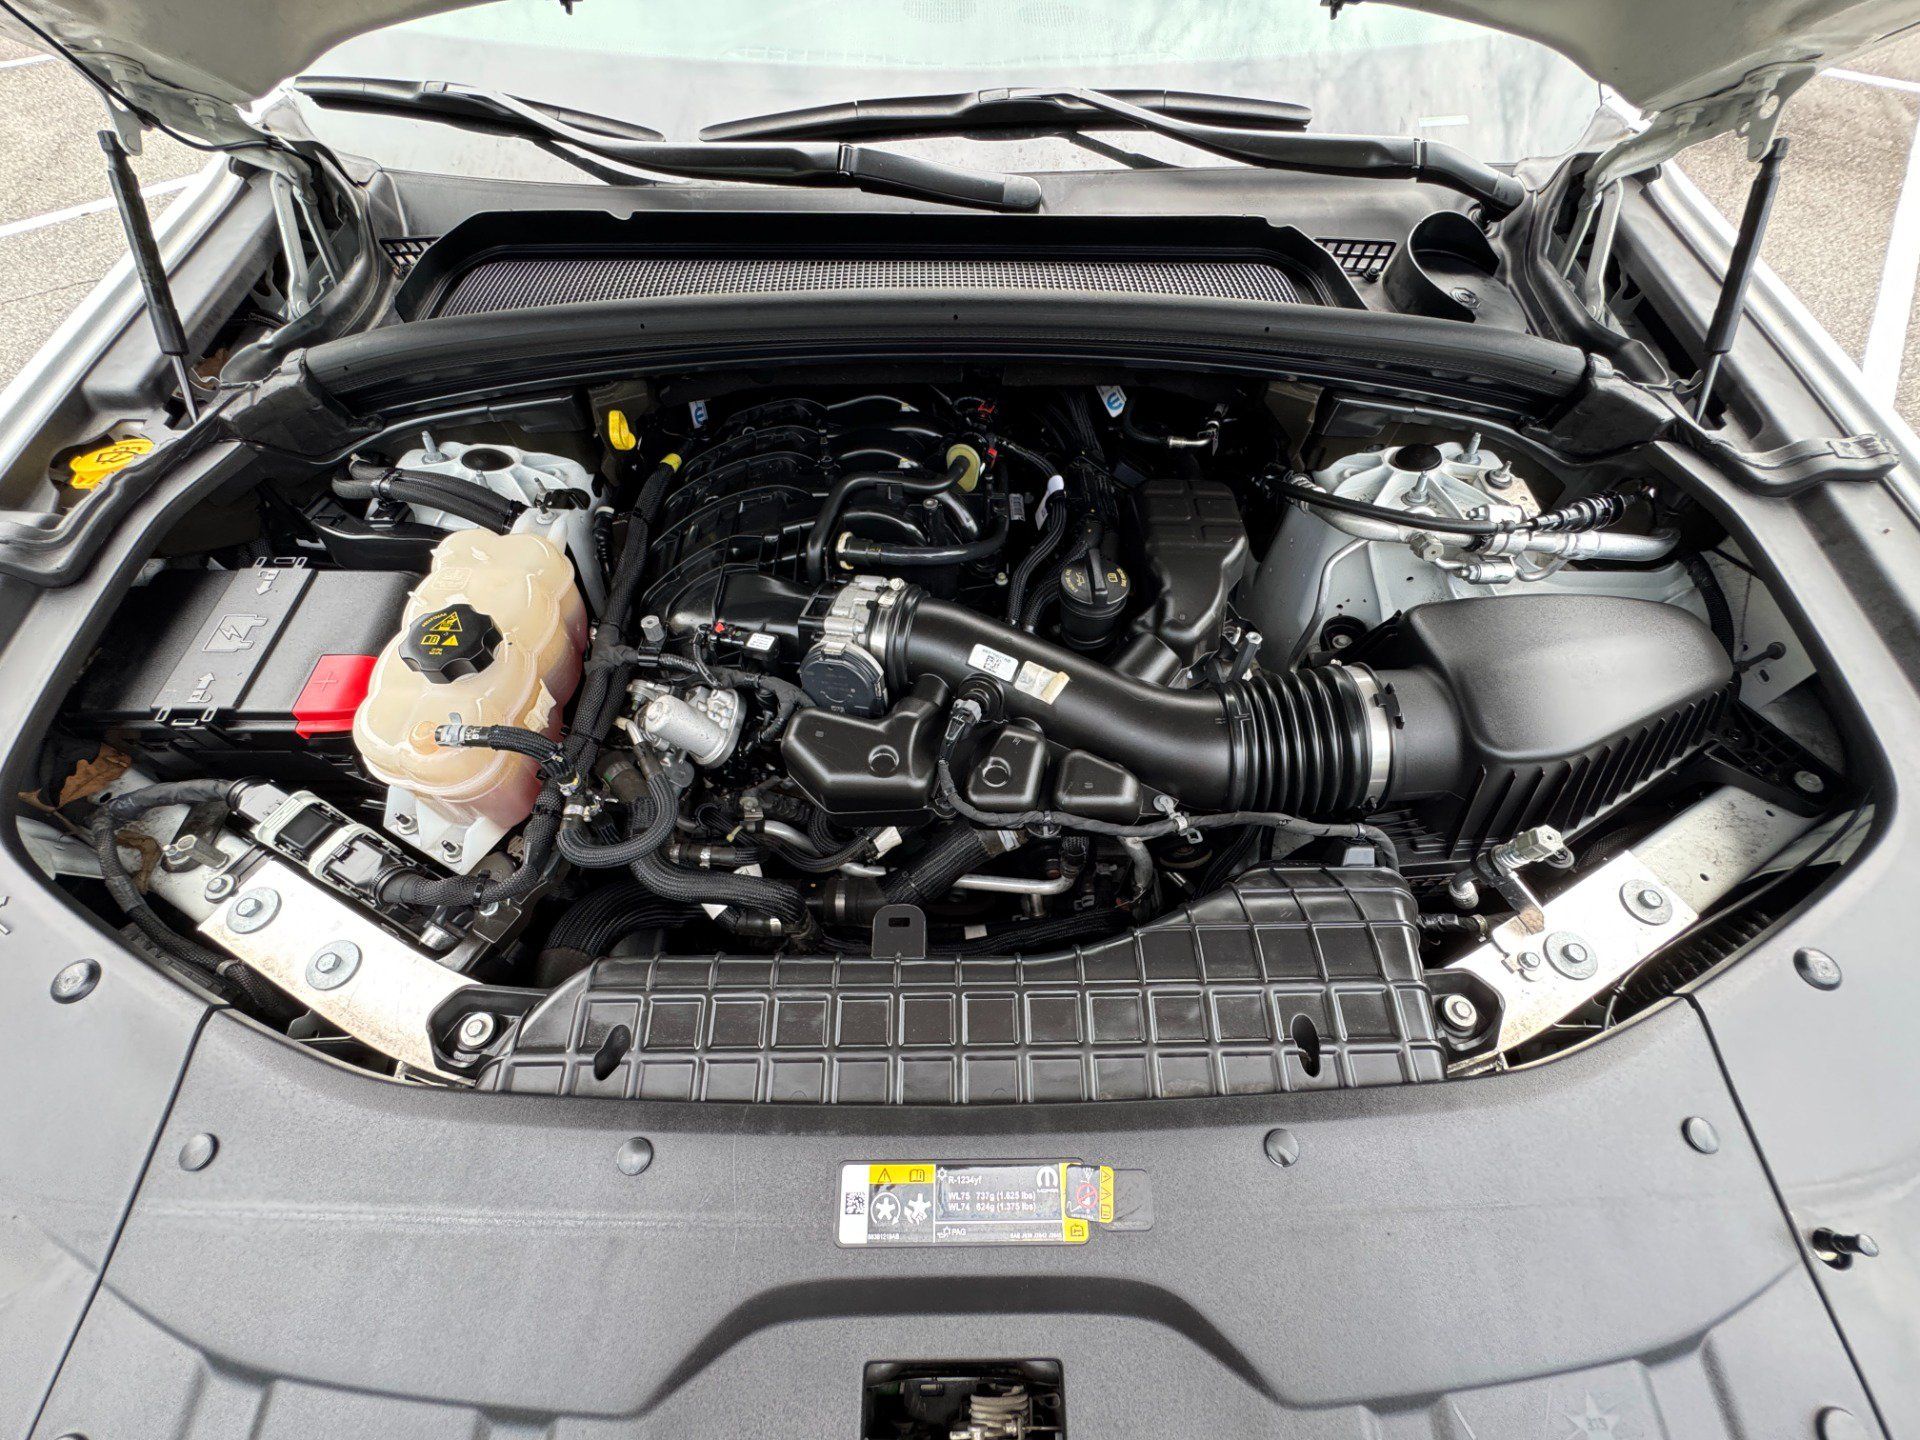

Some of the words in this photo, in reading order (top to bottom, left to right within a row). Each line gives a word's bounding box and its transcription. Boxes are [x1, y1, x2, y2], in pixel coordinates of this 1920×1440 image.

[948, 1175, 982, 1185] R-1234yf
[948, 1192, 970, 1200] WL75
[976, 1192, 995, 1202] 737g
[997, 1191, 1020, 1201] (1.625
[1021, 1191, 1036, 1201] lbs)
[948, 1203, 970, 1211] WL74
[976, 1203, 995, 1212] 624g
[997, 1202, 1020, 1212] (1.375
[1021, 1202, 1036, 1212] lbs)
[951, 1228, 966, 1236] PAG
